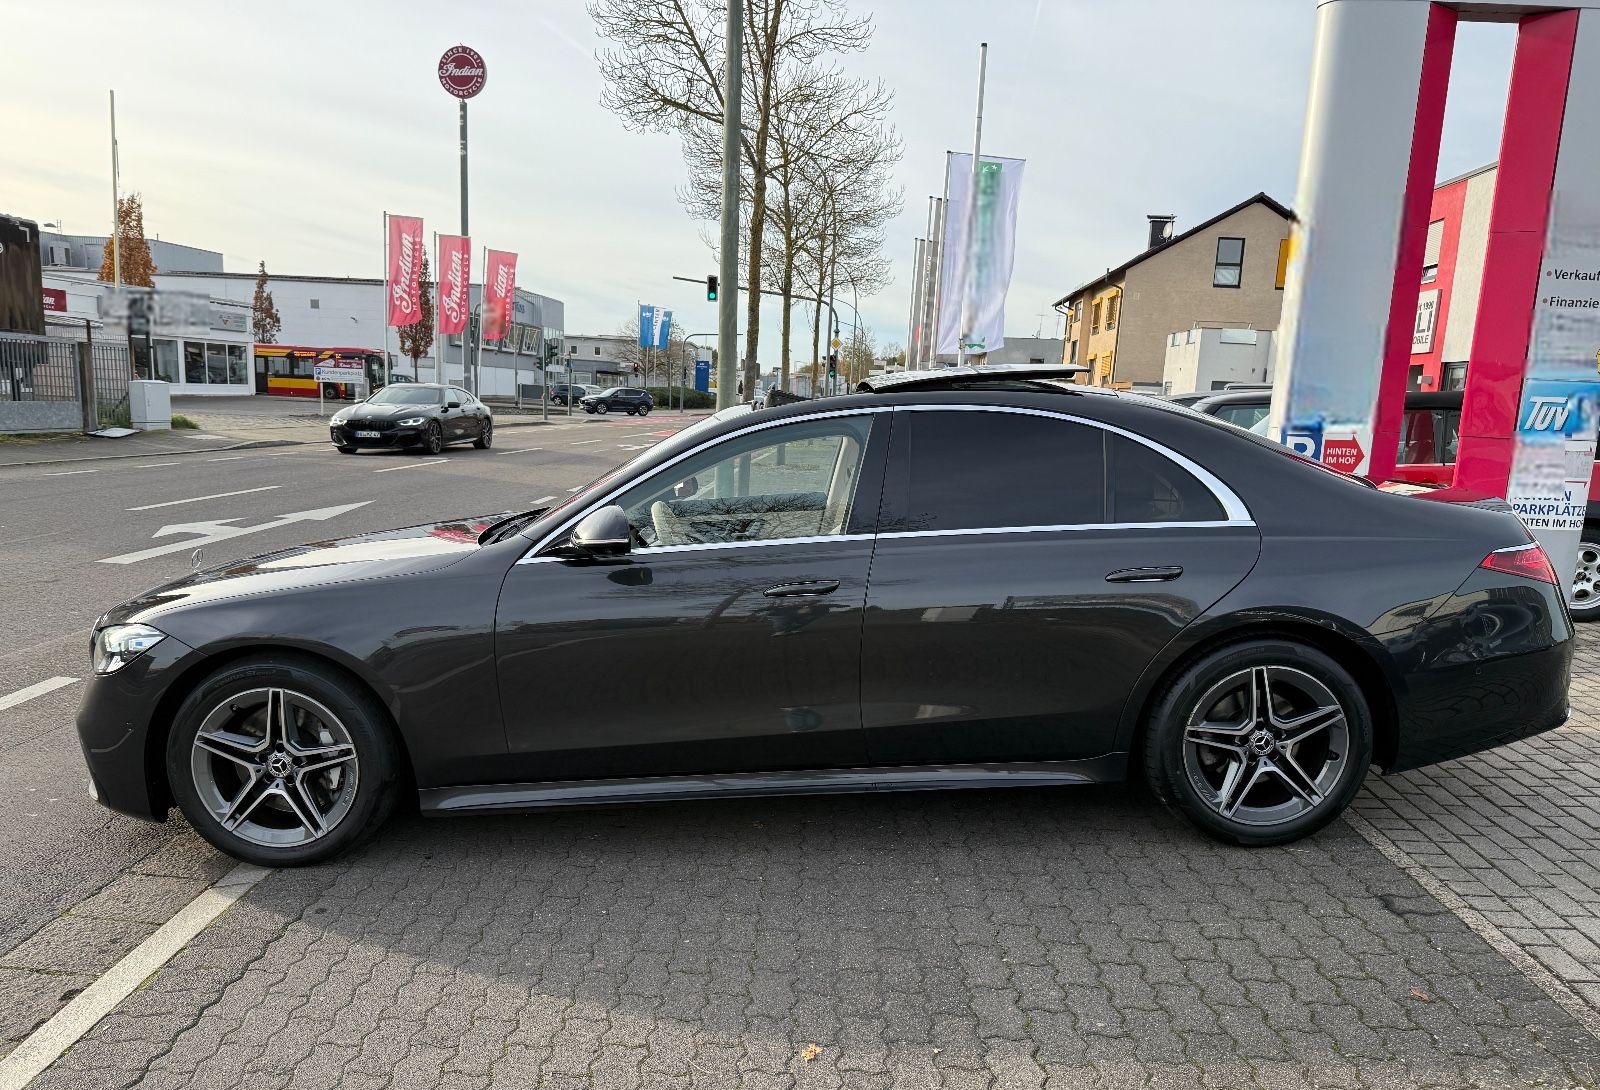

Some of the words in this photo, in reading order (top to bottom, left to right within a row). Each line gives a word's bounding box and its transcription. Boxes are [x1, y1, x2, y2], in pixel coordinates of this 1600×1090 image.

[441, 48, 462, 63] SINCE
[438, 62, 484, 77] Indian
[441, 78, 482, 96] MOTORCYCLE
[392, 232, 414, 314] Indian
[411, 237, 420, 311] MOTORCYCLE
[442, 250, 463, 323] Indian
[461, 254, 469, 320] MOTORCYCLE
[1326, 447, 1358, 456] HINTEN
[1325, 456, 1337, 464] IM
[1338, 457, 1356, 465] HOF
[1552, 518, 1567, 528] IM
